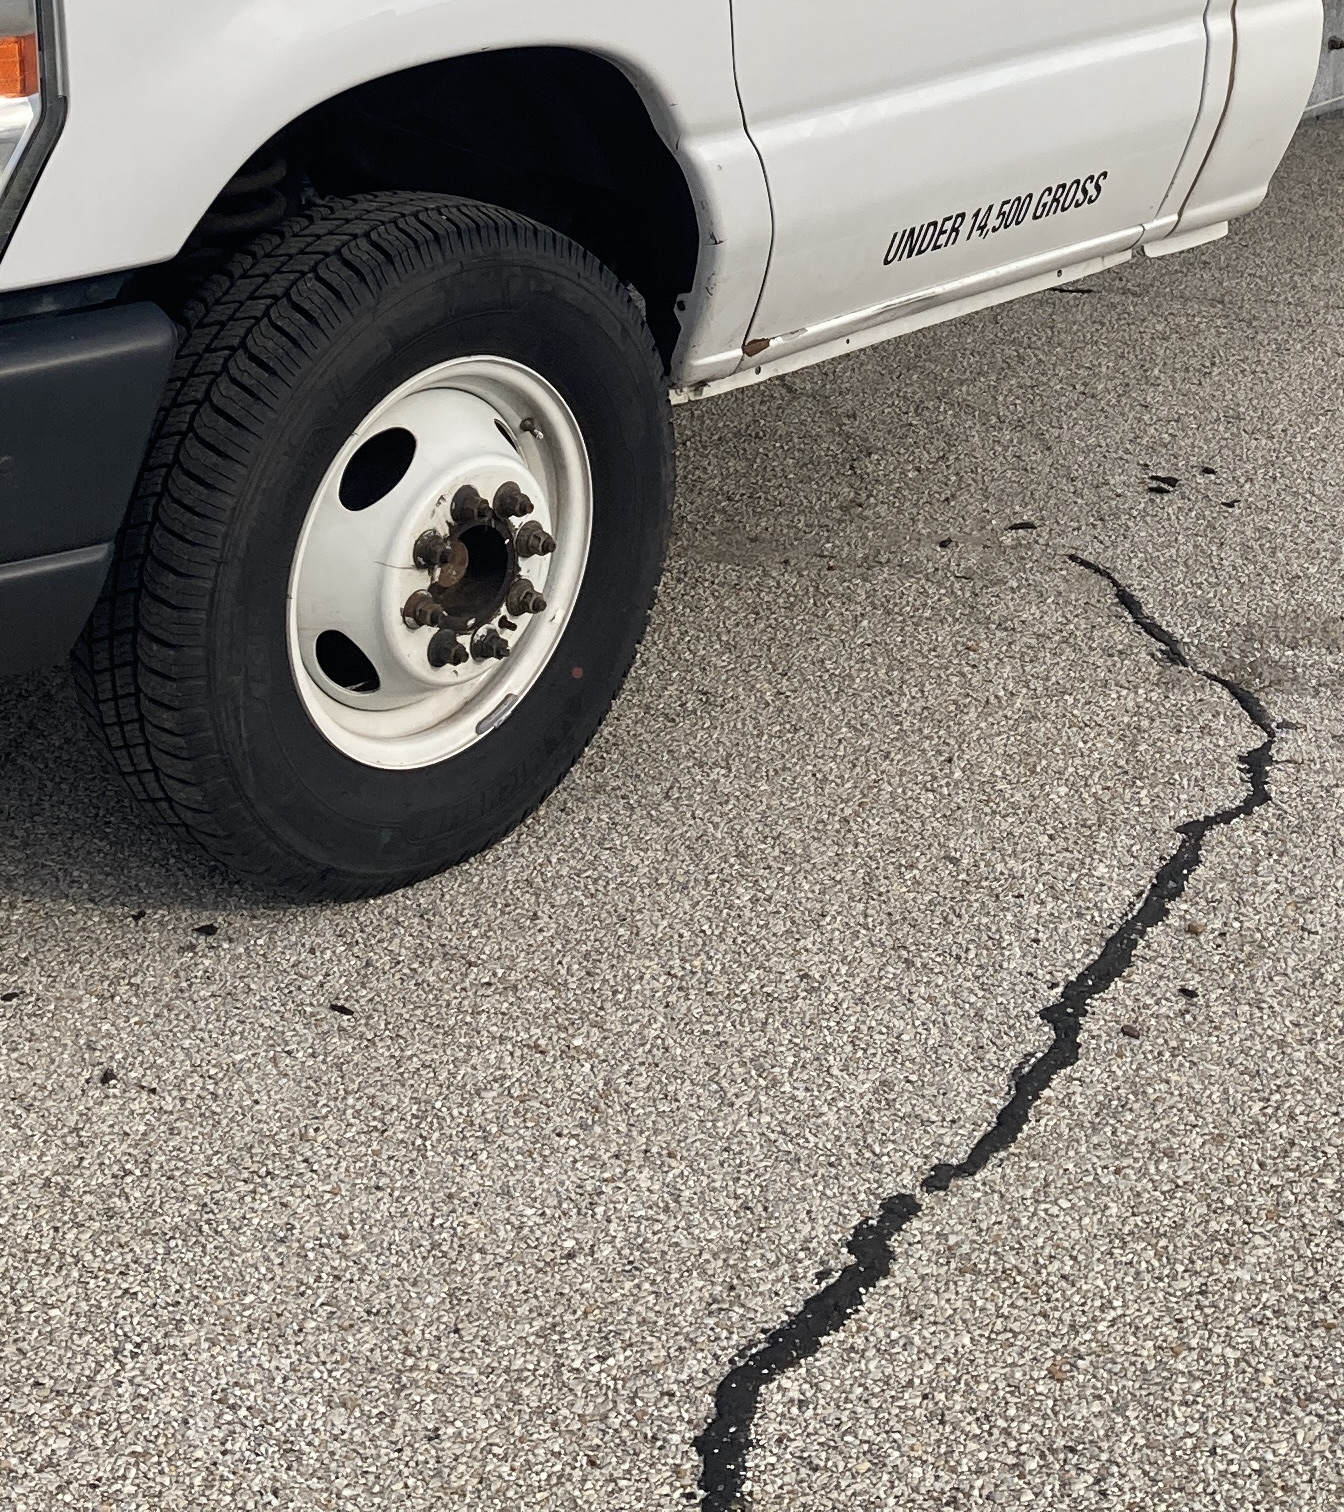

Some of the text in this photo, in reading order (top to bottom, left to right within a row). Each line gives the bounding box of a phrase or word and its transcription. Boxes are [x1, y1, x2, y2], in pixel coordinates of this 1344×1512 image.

[882, 170, 1109, 266] UNDER 14,500 GROSS
